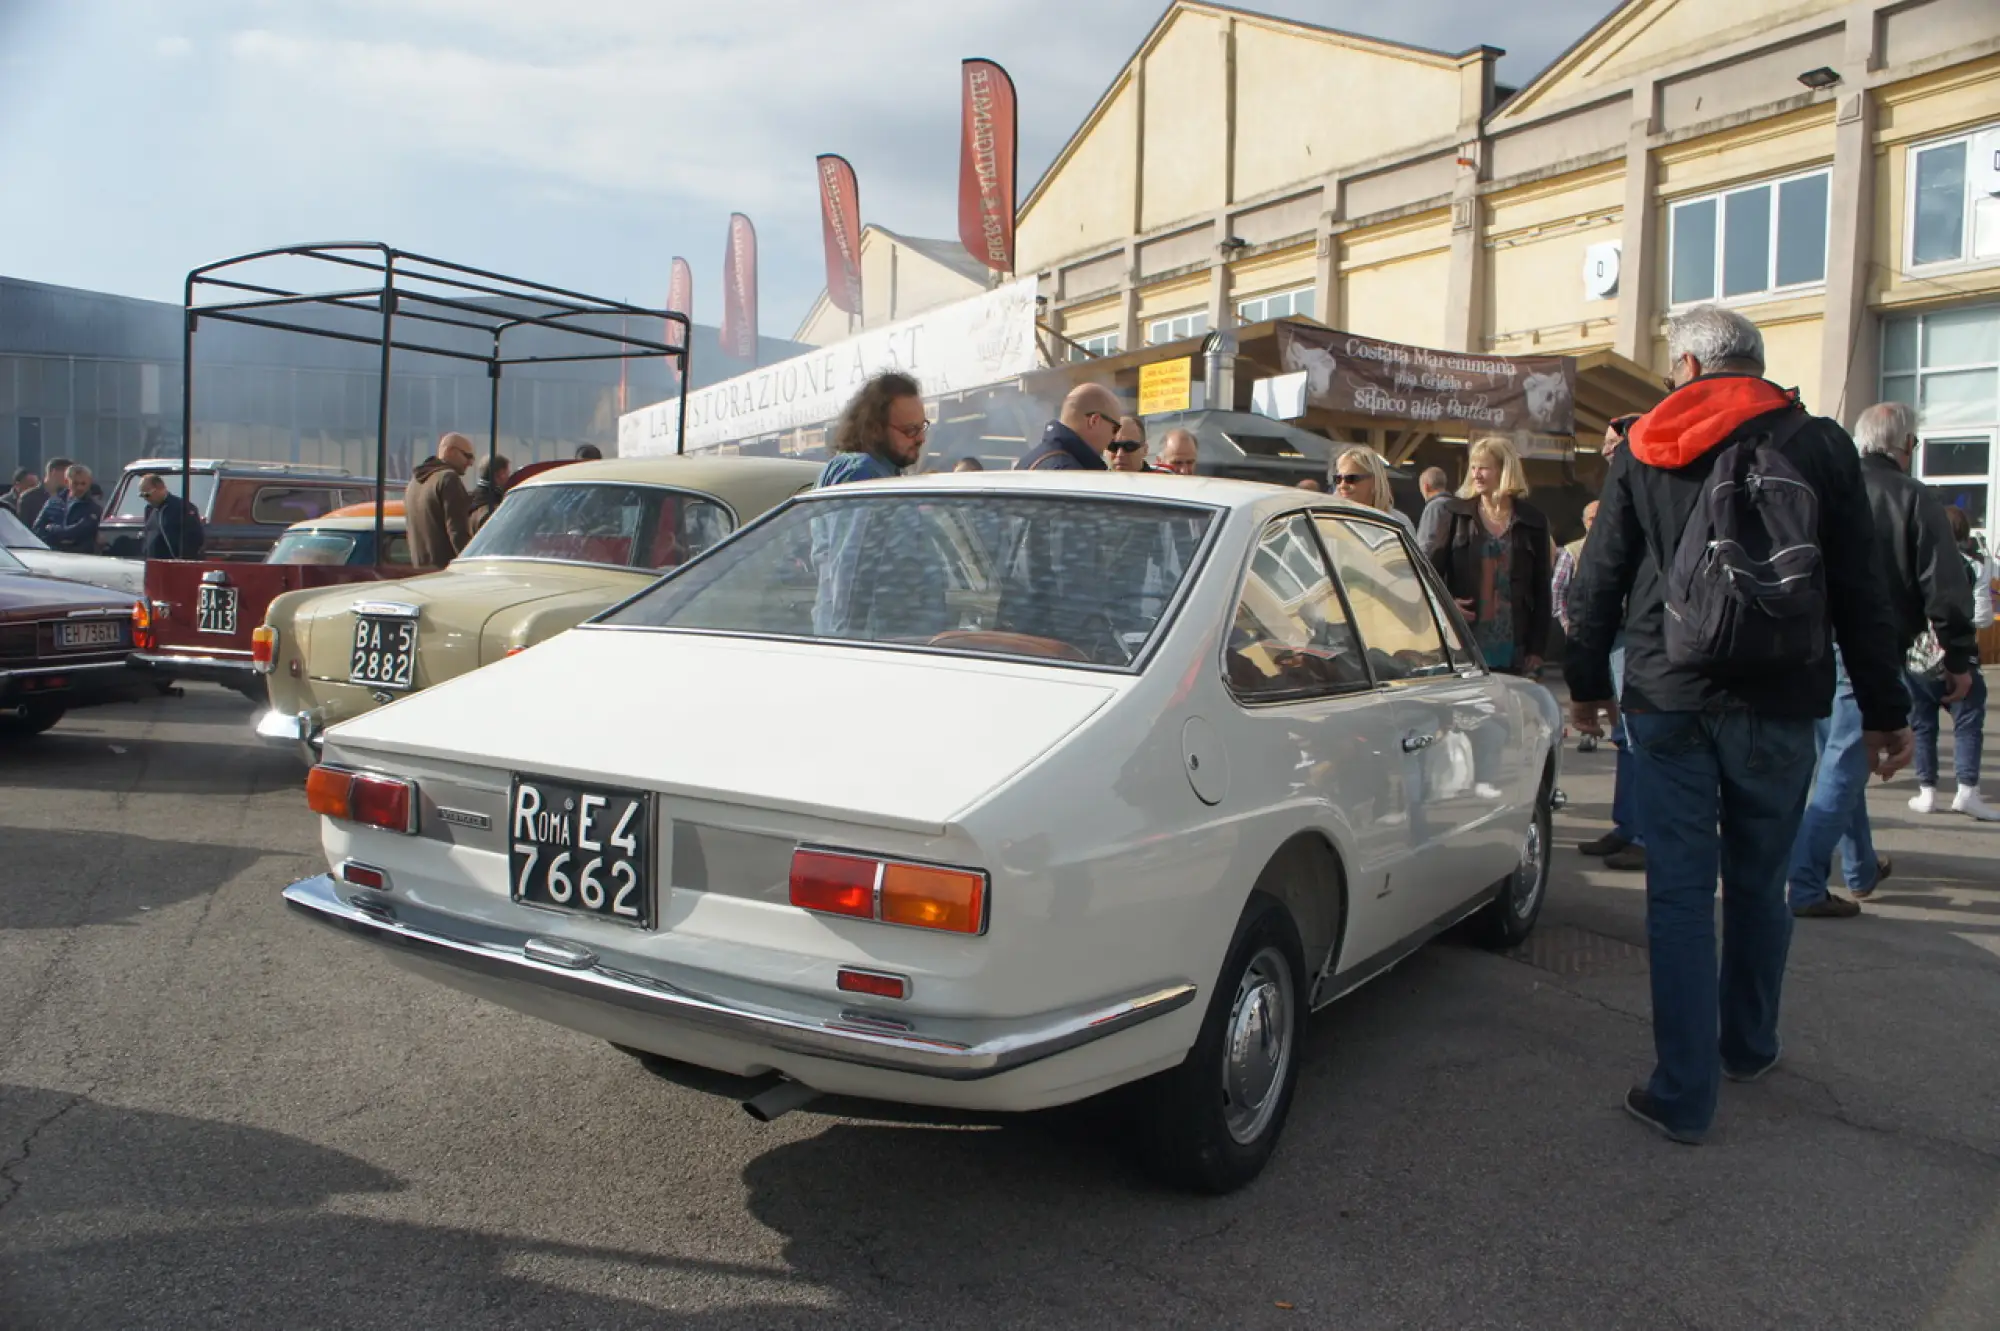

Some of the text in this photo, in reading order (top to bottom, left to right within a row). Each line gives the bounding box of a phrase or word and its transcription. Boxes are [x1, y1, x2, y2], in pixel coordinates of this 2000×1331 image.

[1345, 338, 1517, 376] Costata Maremmana
[650, 408, 670, 439] LA
[849, 343, 865, 386] A
[1464, 380, 1474, 390] e
[1353, 386, 1407, 414] Stinco
[1410, 397, 1441, 420] alla
[201, 589, 216, 609] BA
[200, 609, 233, 630] 7113
[356, 620, 381, 650] BA
[352, 649, 409, 682] 2882
[514, 844, 639, 917] 7662
